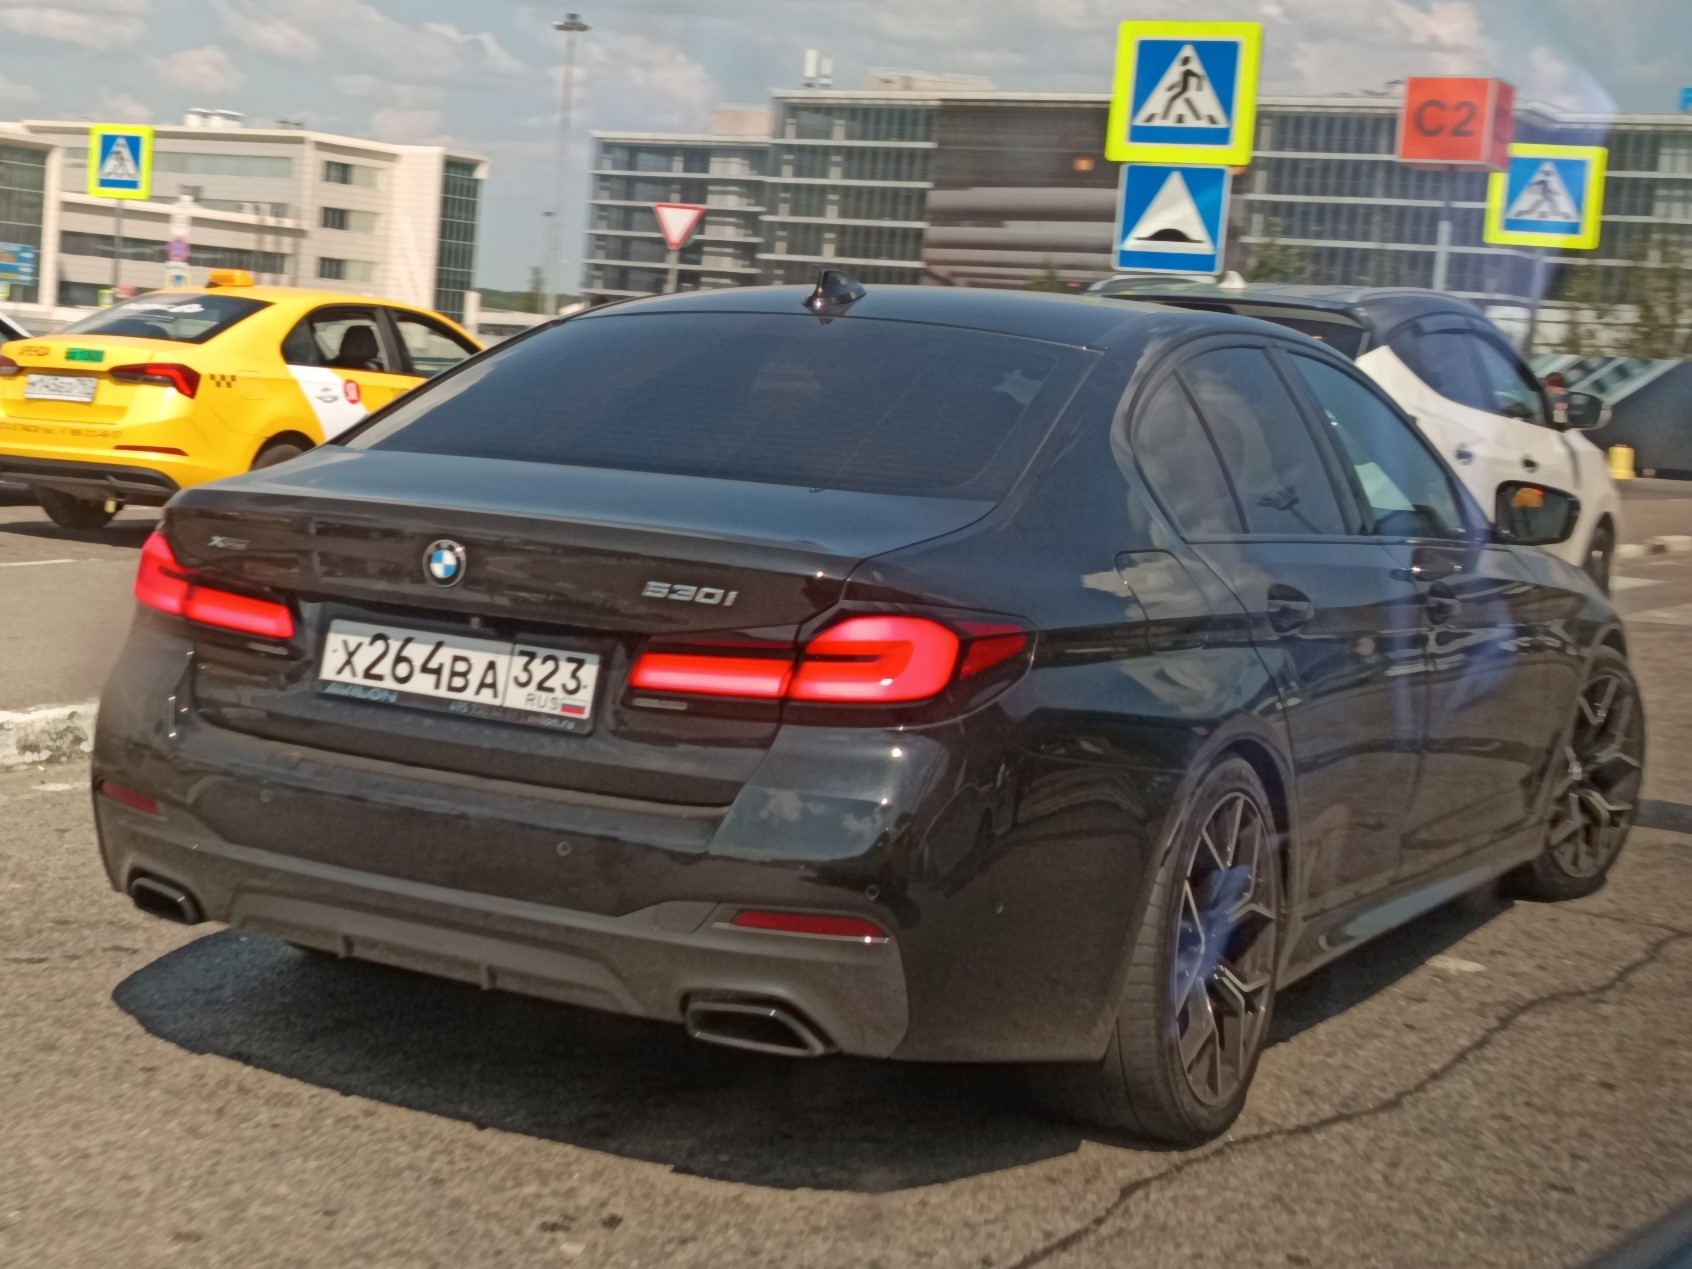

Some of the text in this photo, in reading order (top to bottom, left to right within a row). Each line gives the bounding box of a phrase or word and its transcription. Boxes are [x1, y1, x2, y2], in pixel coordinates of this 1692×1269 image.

[1414, 99, 1478, 138] C2
[513, 649, 586, 697] 323
[524, 692, 560, 711] RUS
